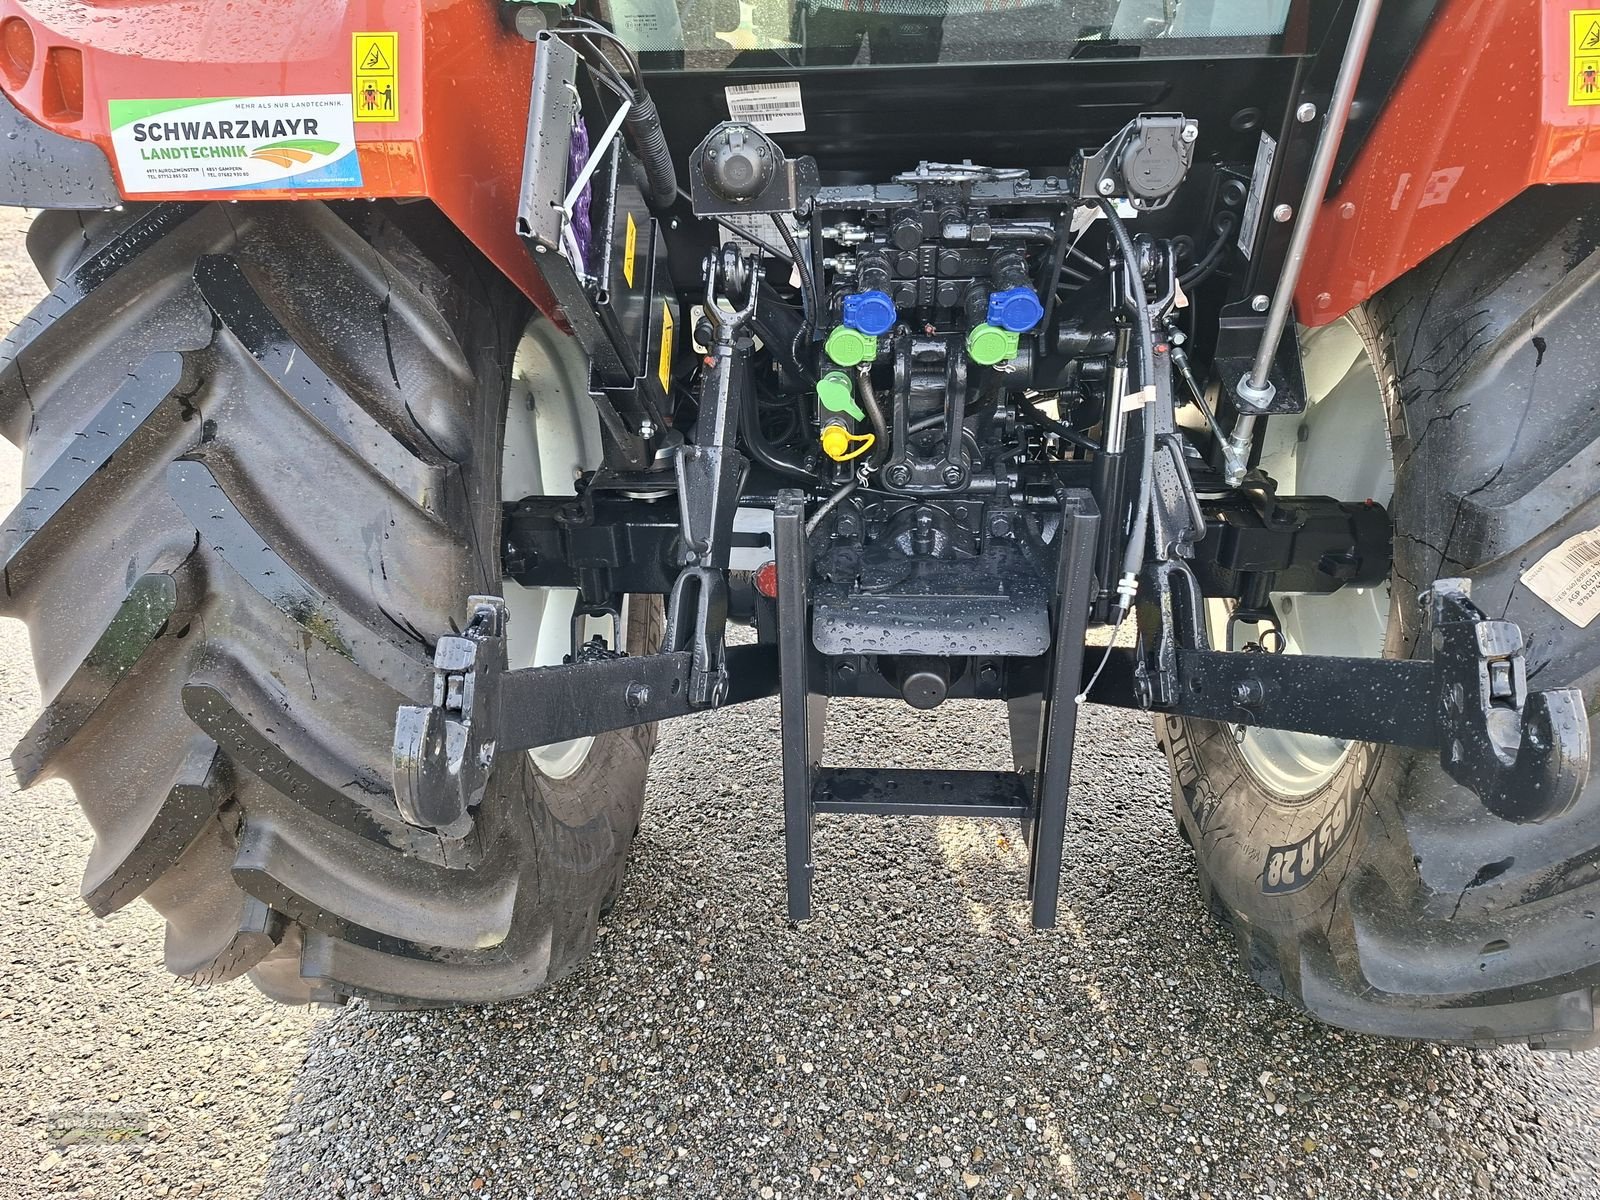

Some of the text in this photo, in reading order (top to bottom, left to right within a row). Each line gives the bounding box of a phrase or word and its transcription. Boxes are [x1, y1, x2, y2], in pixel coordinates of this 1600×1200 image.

[133, 118, 319, 142] SCHWARZMAYR
[140, 145, 248, 160] LANDTECHNIK
[1555, 590, 1567, 602] NEW
[1568, 590, 1581, 604] AGP
[1301, 833, 1317, 876] R
[1267, 848, 1298, 887] 28
